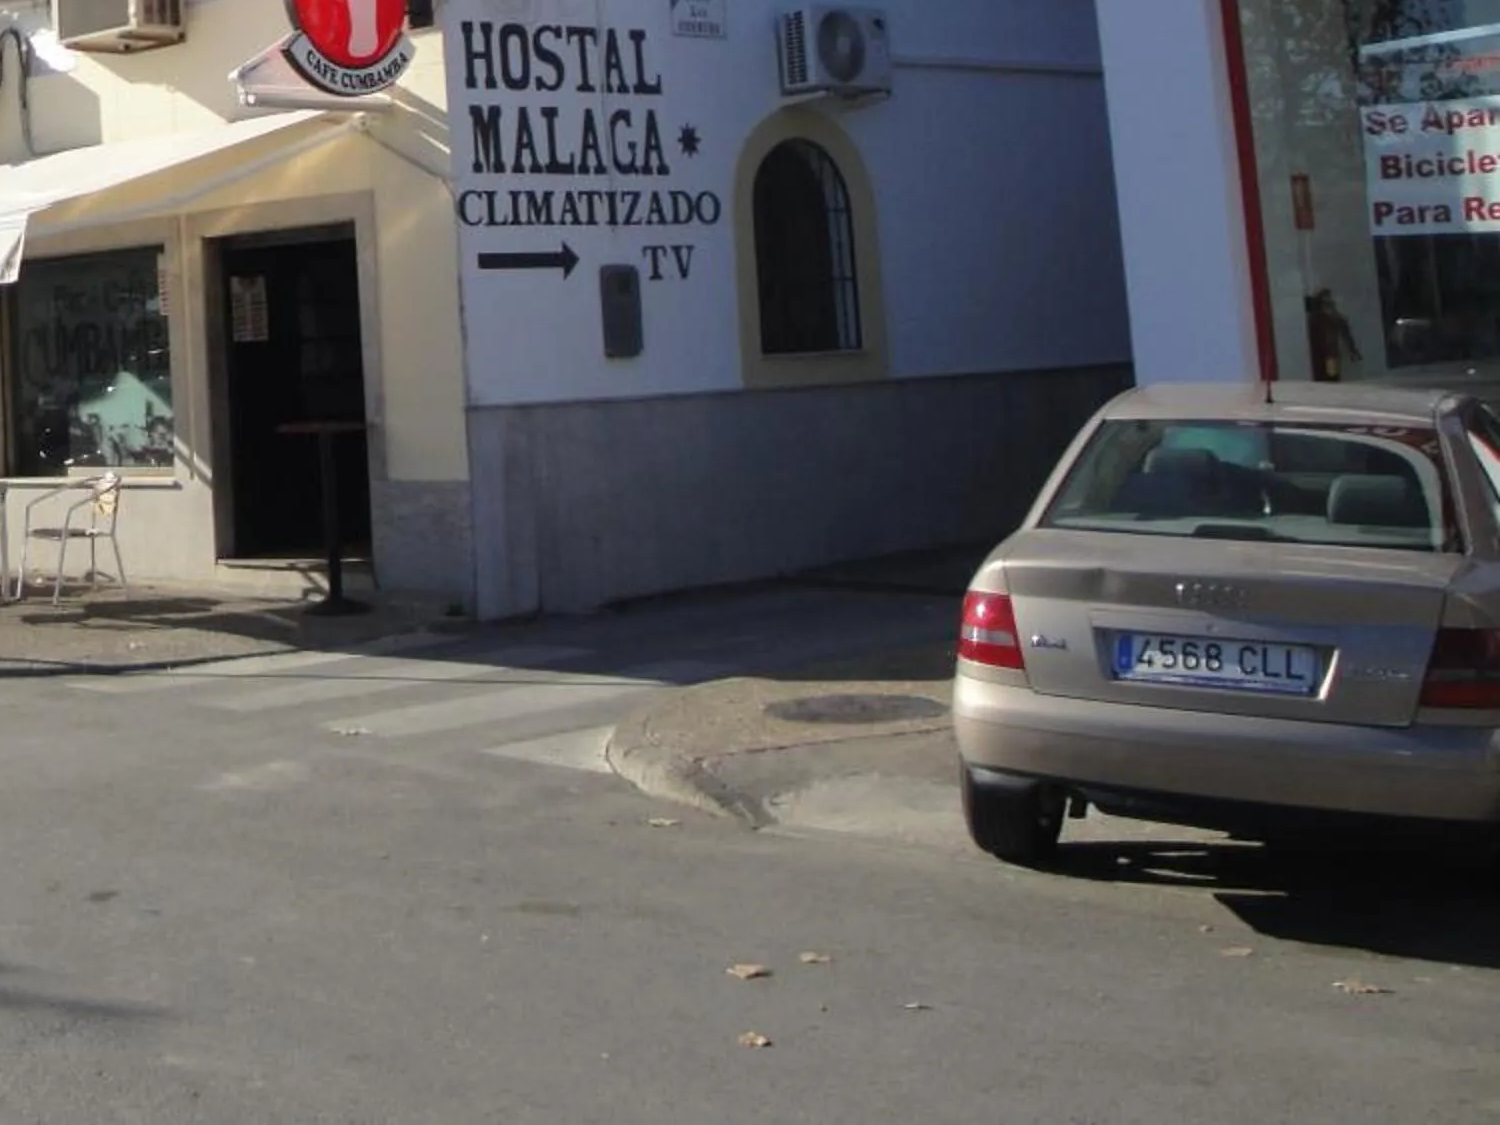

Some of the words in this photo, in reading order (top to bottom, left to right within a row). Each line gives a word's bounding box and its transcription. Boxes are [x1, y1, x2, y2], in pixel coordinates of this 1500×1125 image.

[460, 21, 662, 95] HOSTAL
[468, 105, 671, 176] MALAGA
[1366, 110, 1408, 135] Se
[457, 190, 722, 227] CLIMATIZADO
[1373, 202, 1452, 226] Para
[643, 245, 695, 281] TV
[1137, 637, 1223, 673] 4568
[1237, 645, 1306, 683] CLL
